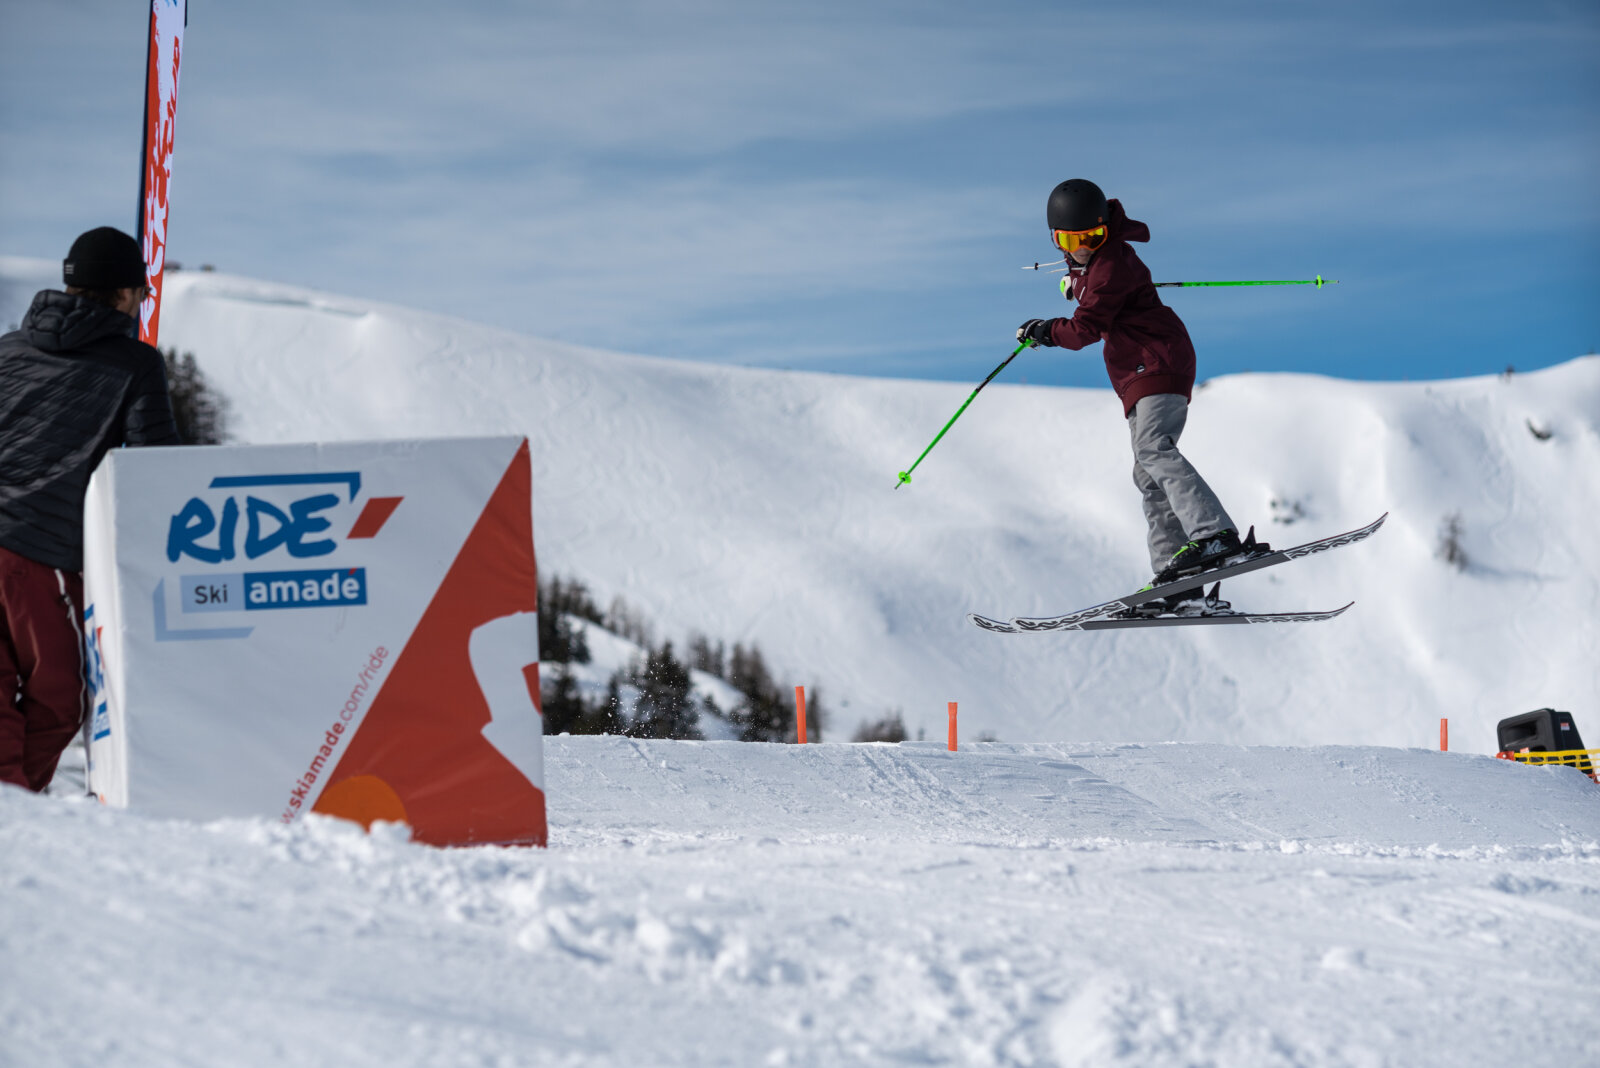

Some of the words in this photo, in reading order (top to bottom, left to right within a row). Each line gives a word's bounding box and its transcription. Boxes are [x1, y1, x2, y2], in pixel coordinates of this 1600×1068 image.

[166, 493, 340, 564] RIDE
[194, 584, 228, 605] Ski
[249, 567, 360, 604] amadé
